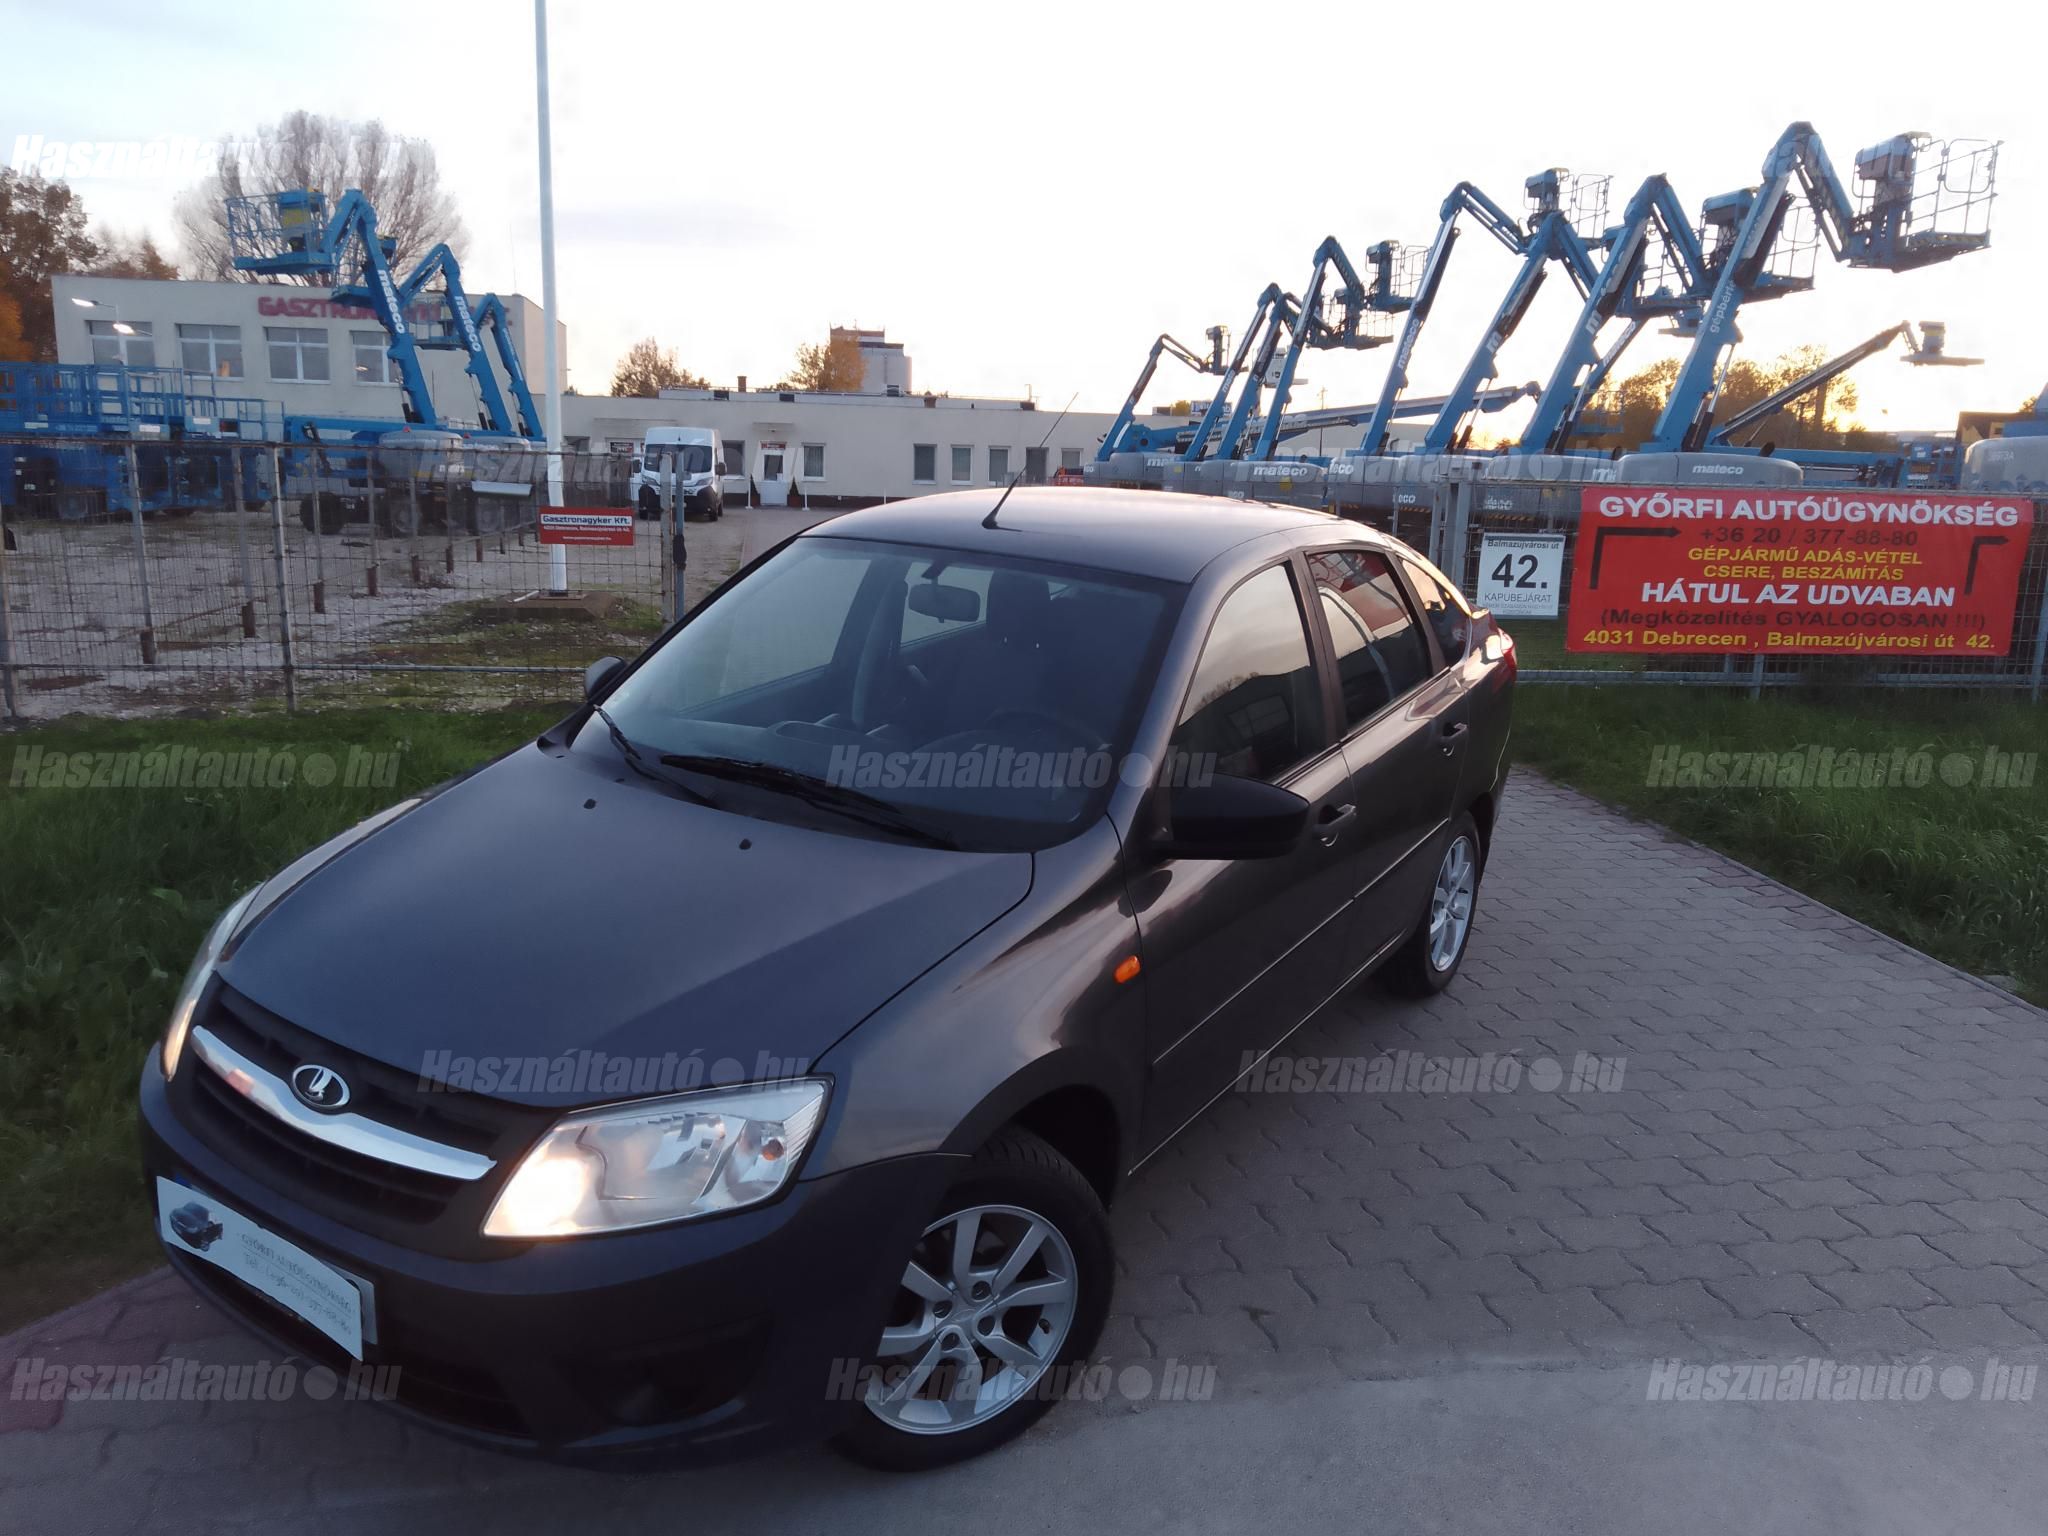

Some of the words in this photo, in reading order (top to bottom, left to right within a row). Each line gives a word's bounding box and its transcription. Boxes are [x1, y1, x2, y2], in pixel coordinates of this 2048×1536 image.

[377, 269, 405, 334] mateco
[454, 295, 481, 352] mateco
[1253, 465, 1308, 477] mateco
[1692, 463, 1744, 475] mateco
[1600, 493, 1723, 519] GYŐRFI
[1730, 496, 2018, 527] AUTÓÜGYNÖKSÉG
[1702, 527, 1744, 544] +36
[1752, 527, 1781, 544] 20
[1803, 529, 1919, 546] 377-88-80
[1688, 546, 1799, 562] GÉPJÁRMŰ
[1802, 548, 1923, 565] ADÁS-VÉTEL
[1491, 553, 1548, 589] 42.
[1703, 565, 1776, 580] CSERE,
[1782, 566, 1904, 581] BESZÁMÍTÁS
[1484, 592, 1553, 602] KAPUBEJÁRAT
[1641, 578, 1750, 603] HÁTUL
[1755, 584, 1800, 604] AZ
[1808, 585, 1956, 607] UDVABAN
[1776, 612, 1948, 628] GYALOGOSAN
[1584, 630, 1634, 645] 4031
[1642, 631, 1747, 646] Debrecen
[1767, 632, 1928, 650] Balmazújvárosi
[1934, 633, 1955, 648] út
[1966, 634, 1995, 648] 42.
